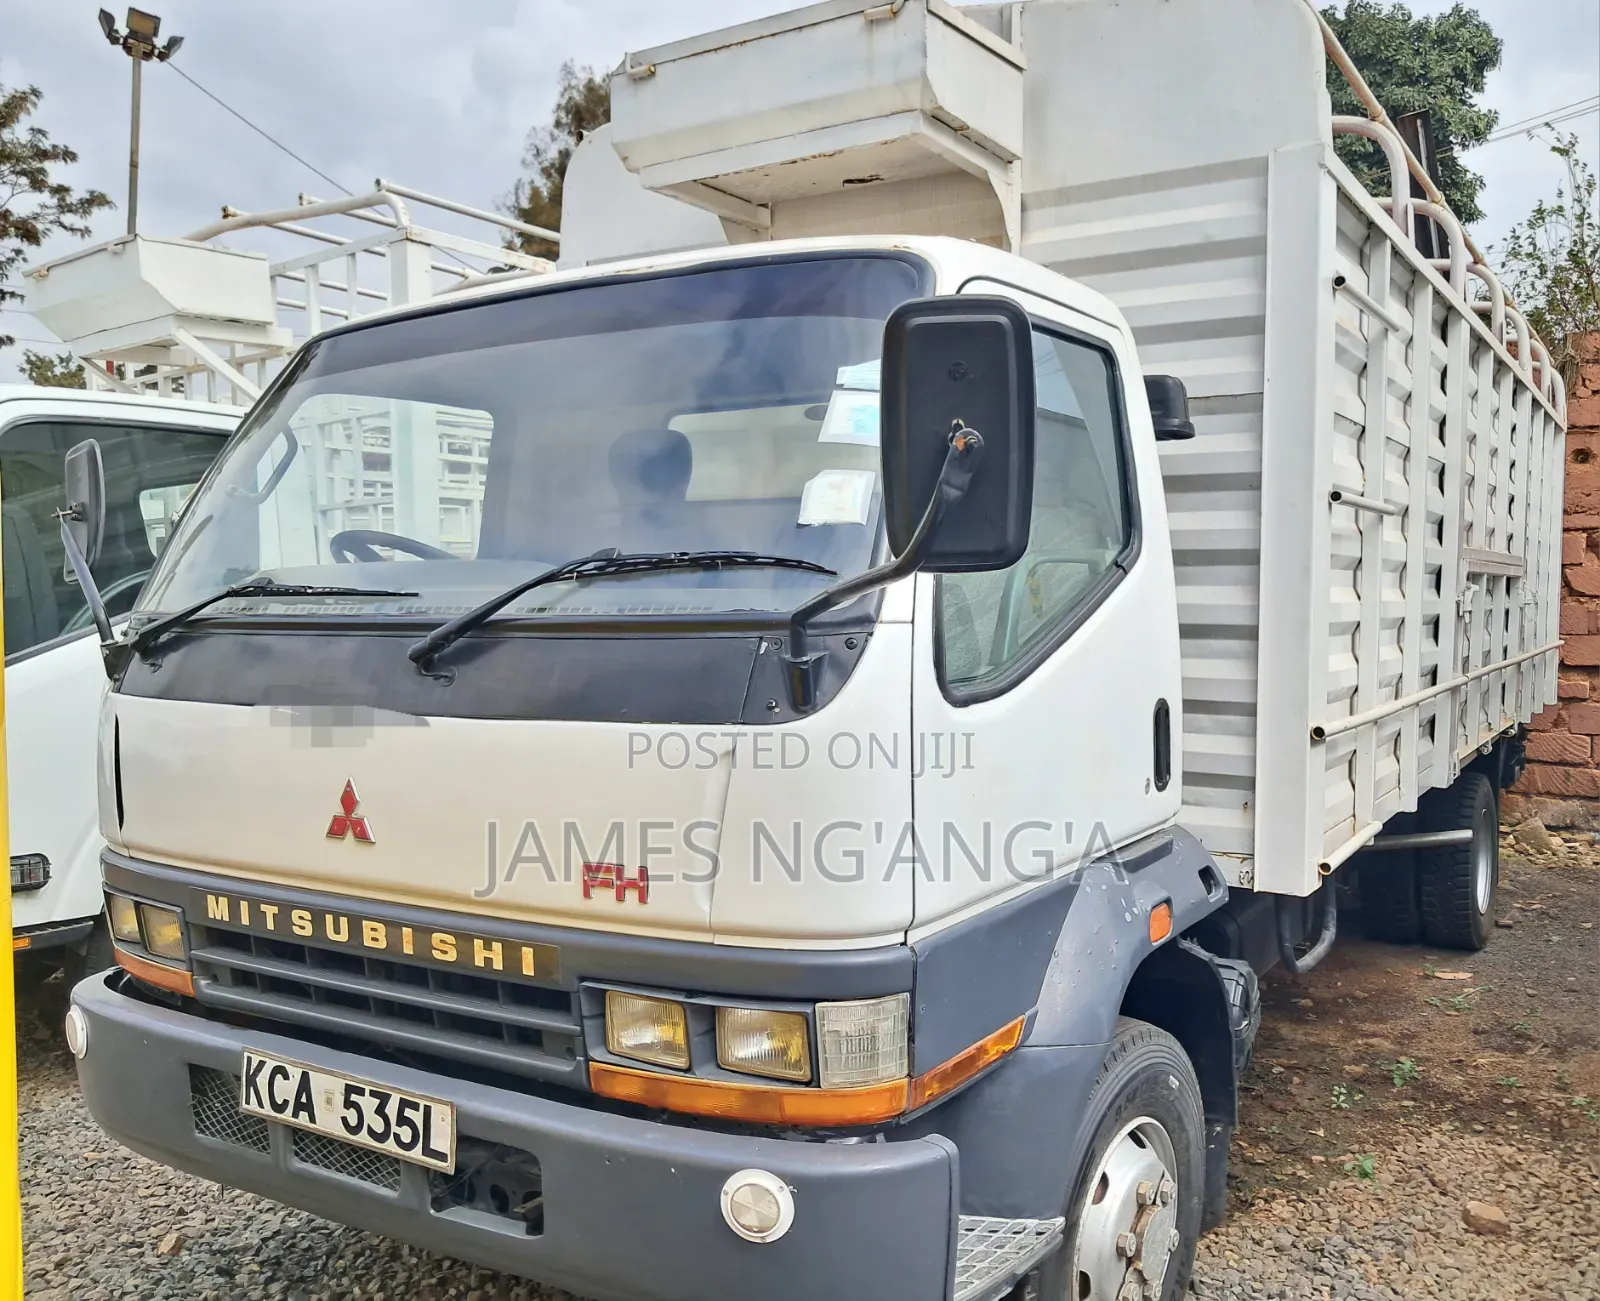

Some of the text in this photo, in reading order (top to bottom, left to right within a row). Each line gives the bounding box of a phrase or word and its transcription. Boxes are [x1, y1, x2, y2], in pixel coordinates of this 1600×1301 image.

[583, 862, 648, 904] FH
[206, 894, 535, 976] MITSUBISHI
[243, 1055, 449, 1163] KCA 535L
